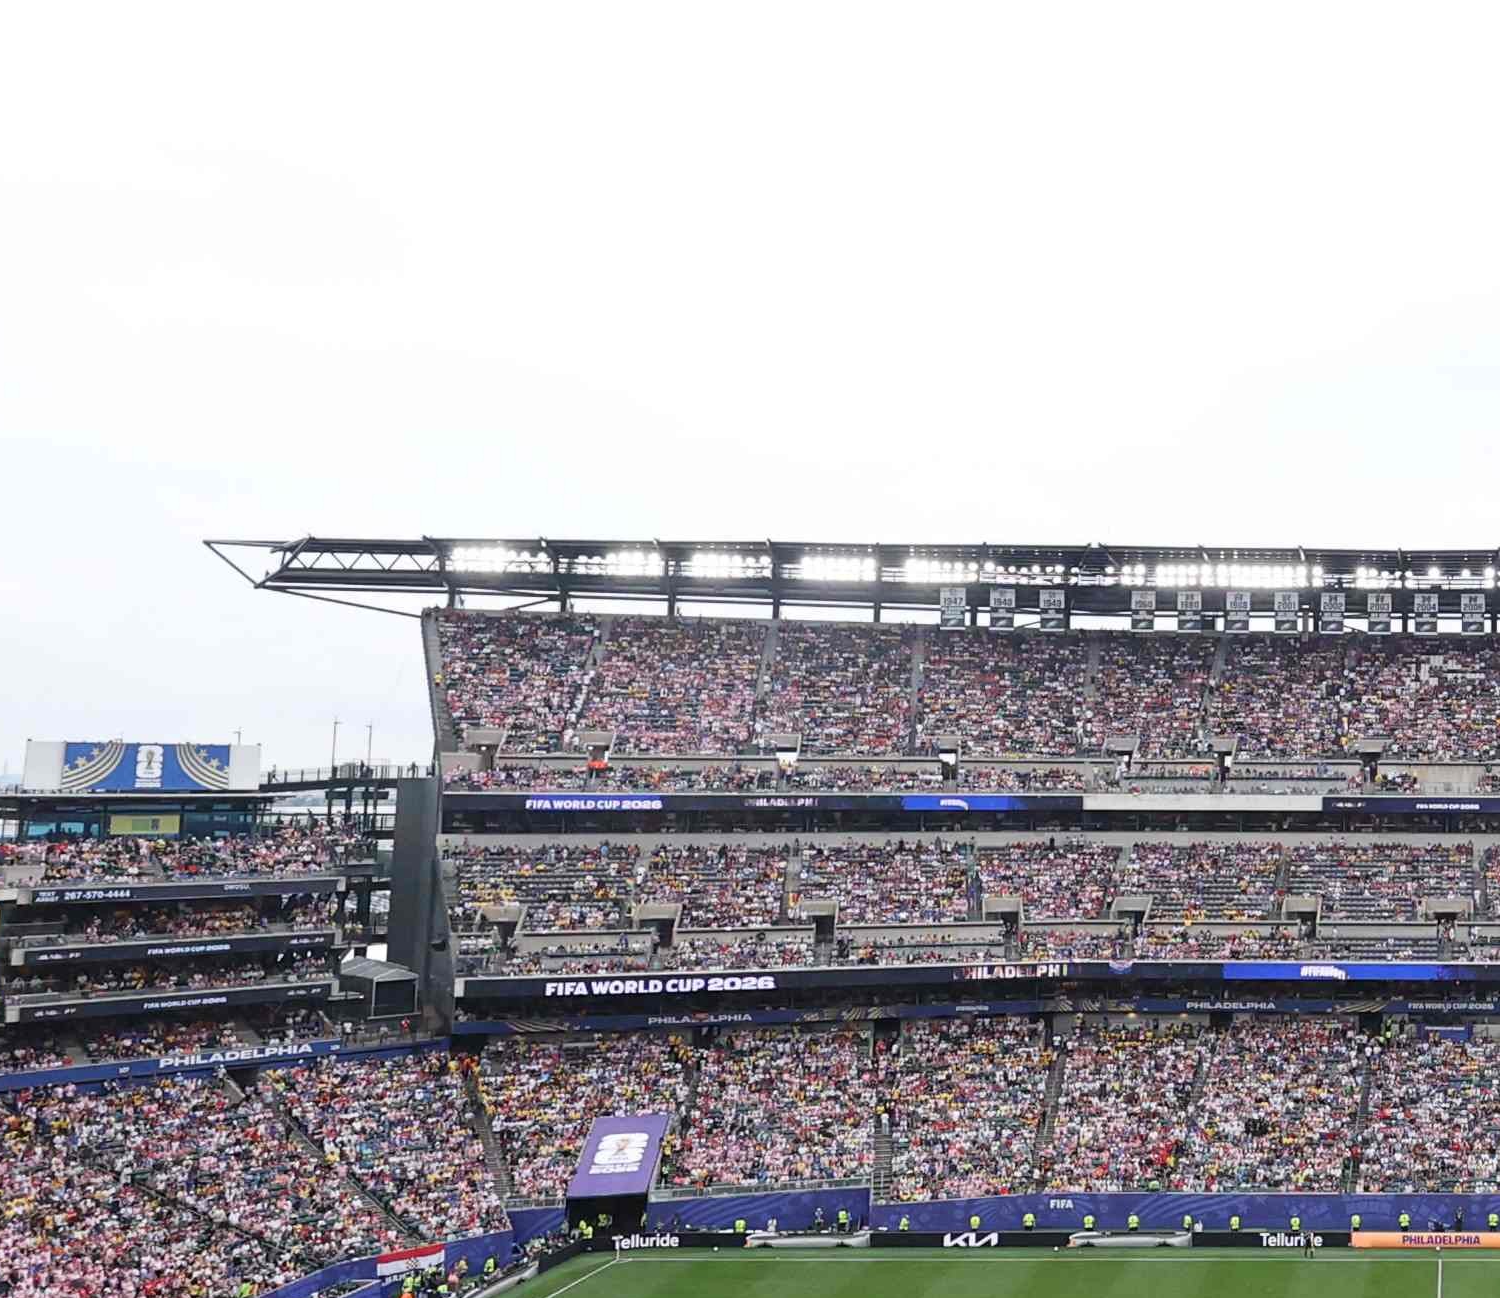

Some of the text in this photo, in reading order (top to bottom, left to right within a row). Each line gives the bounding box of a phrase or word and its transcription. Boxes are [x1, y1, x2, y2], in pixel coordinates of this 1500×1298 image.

[526, 799, 551, 809] FIFA
[552, 799, 595, 809] WORLD
[597, 799, 621, 809] CUP
[545, 976, 776, 997] FIFA WORLD CUP 2026
[1186, 1001, 1276, 1011] PHILADELPHIA
[1408, 1002, 1427, 1011] FIFA
[159, 1043, 313, 1069] PHILADELPHIA
[1049, 1198, 1073, 1209] FIFA
[612, 1233, 680, 1250] Telluride
[1401, 1234, 1481, 1246] PHILADELPHIA
